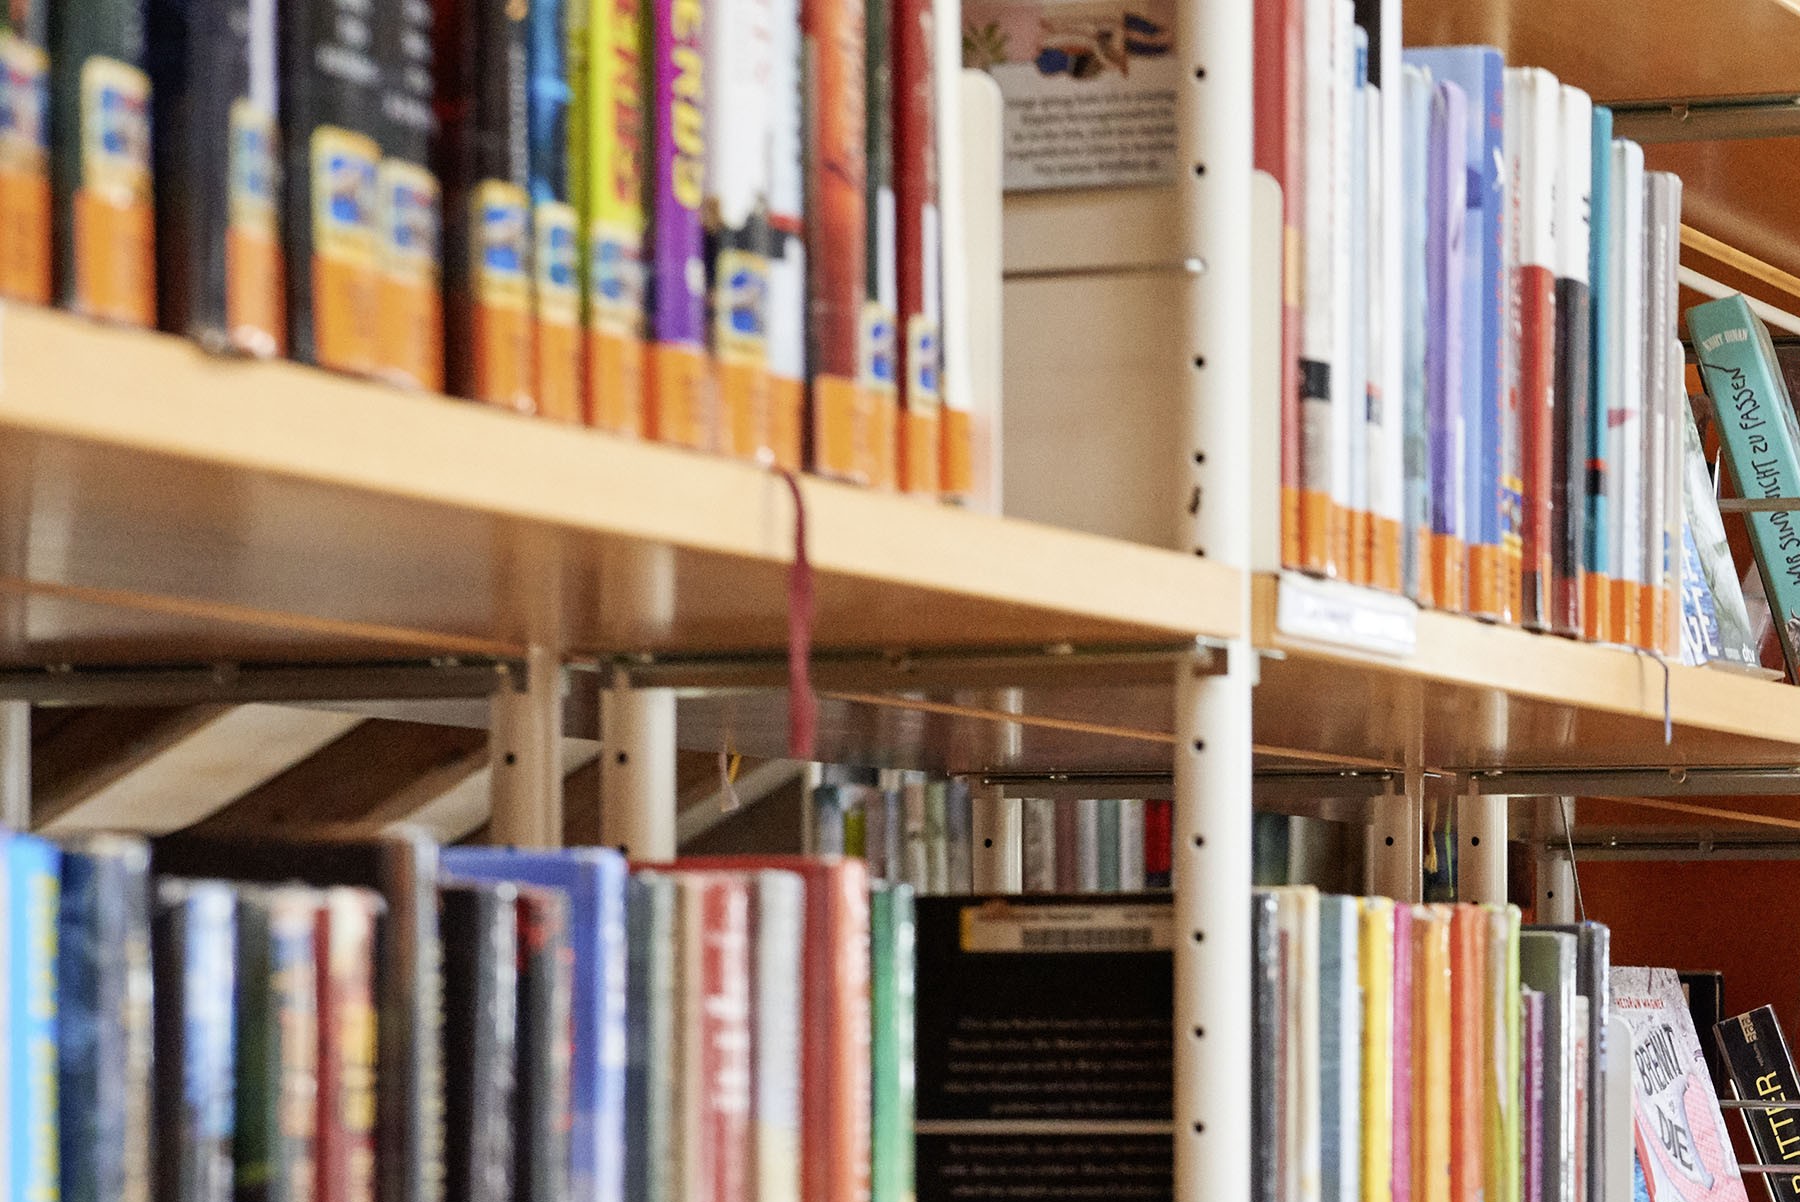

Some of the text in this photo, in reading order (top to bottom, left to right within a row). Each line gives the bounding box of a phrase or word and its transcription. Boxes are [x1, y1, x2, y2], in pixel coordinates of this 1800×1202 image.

[1731, 366, 1766, 430] FASSEN
[1748, 436, 1768, 454] ZU
[1770, 511, 1800, 551] SIND
[1634, 1023, 1684, 1097] BRENNT
[1655, 1103, 1694, 1172] DIE
